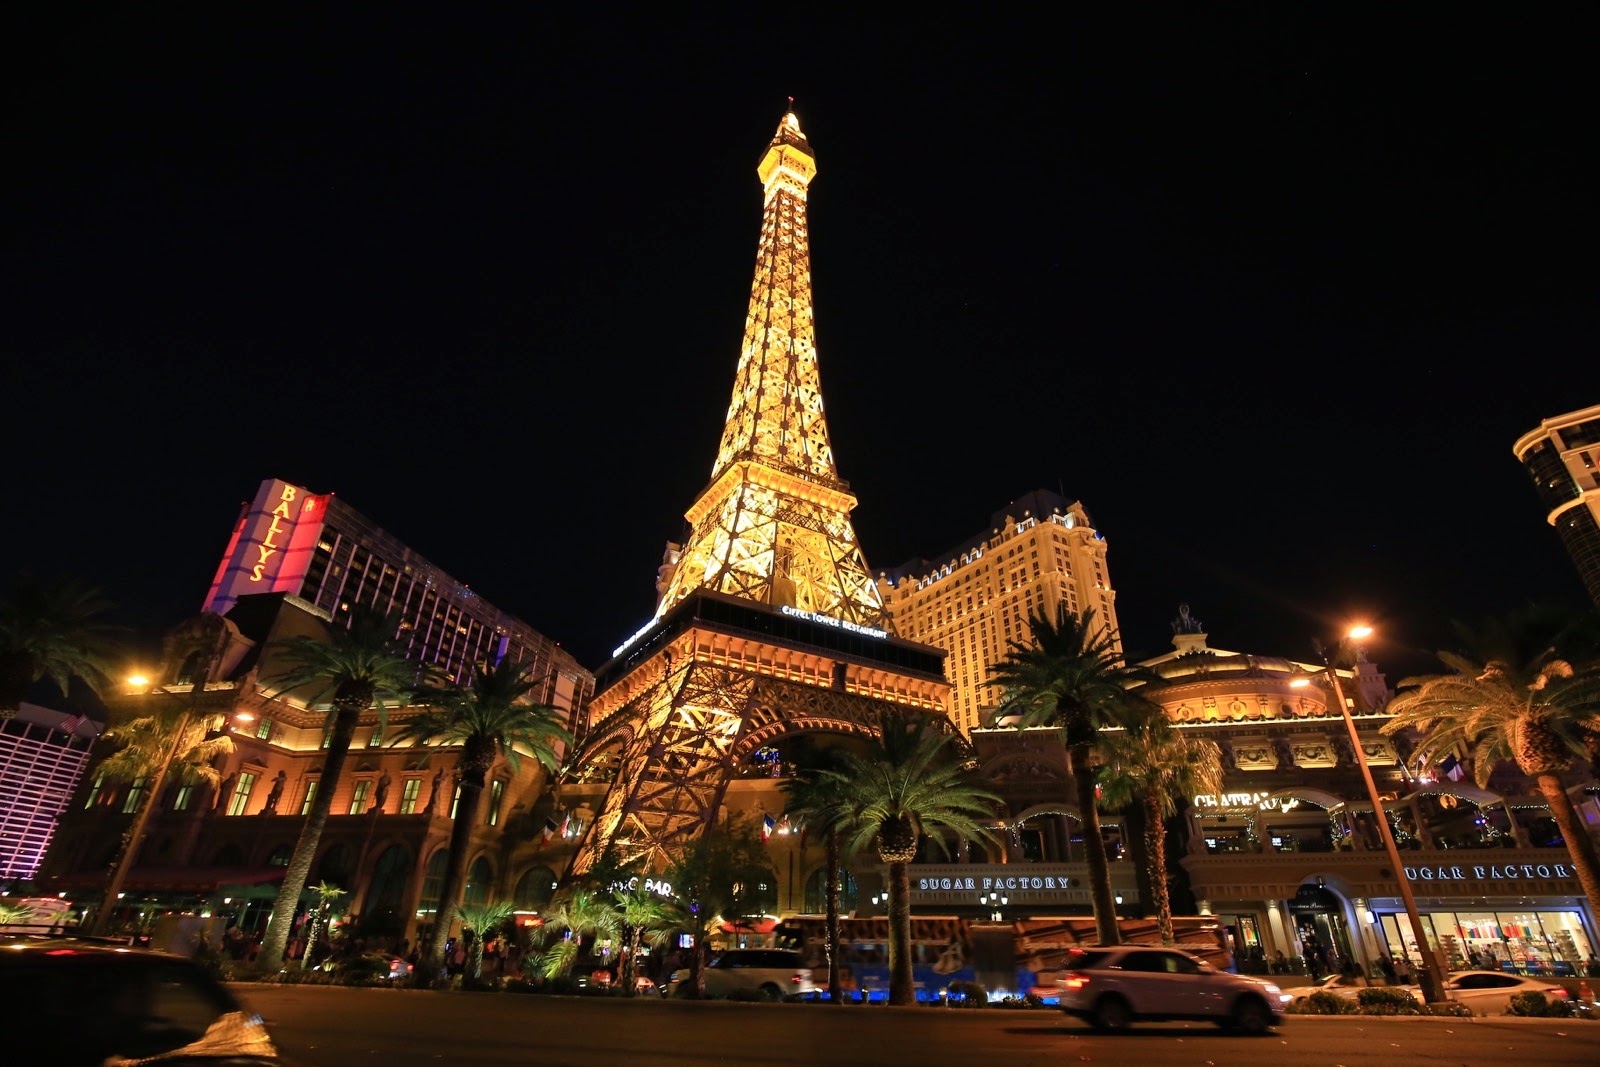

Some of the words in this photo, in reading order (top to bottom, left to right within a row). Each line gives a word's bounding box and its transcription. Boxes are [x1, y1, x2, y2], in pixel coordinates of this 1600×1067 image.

[250, 485, 296, 582] BALLYS
[812, 612, 840, 627] TOWER
[842, 620, 888, 639] RESTAURANT
[1403, 866, 1466, 880] UGAR
[1473, 864, 1577, 880] FACTOR
[644, 878, 672, 897] BAR
[919, 877, 976, 890] SUGAR
[982, 877, 1069, 890] FACTORY
